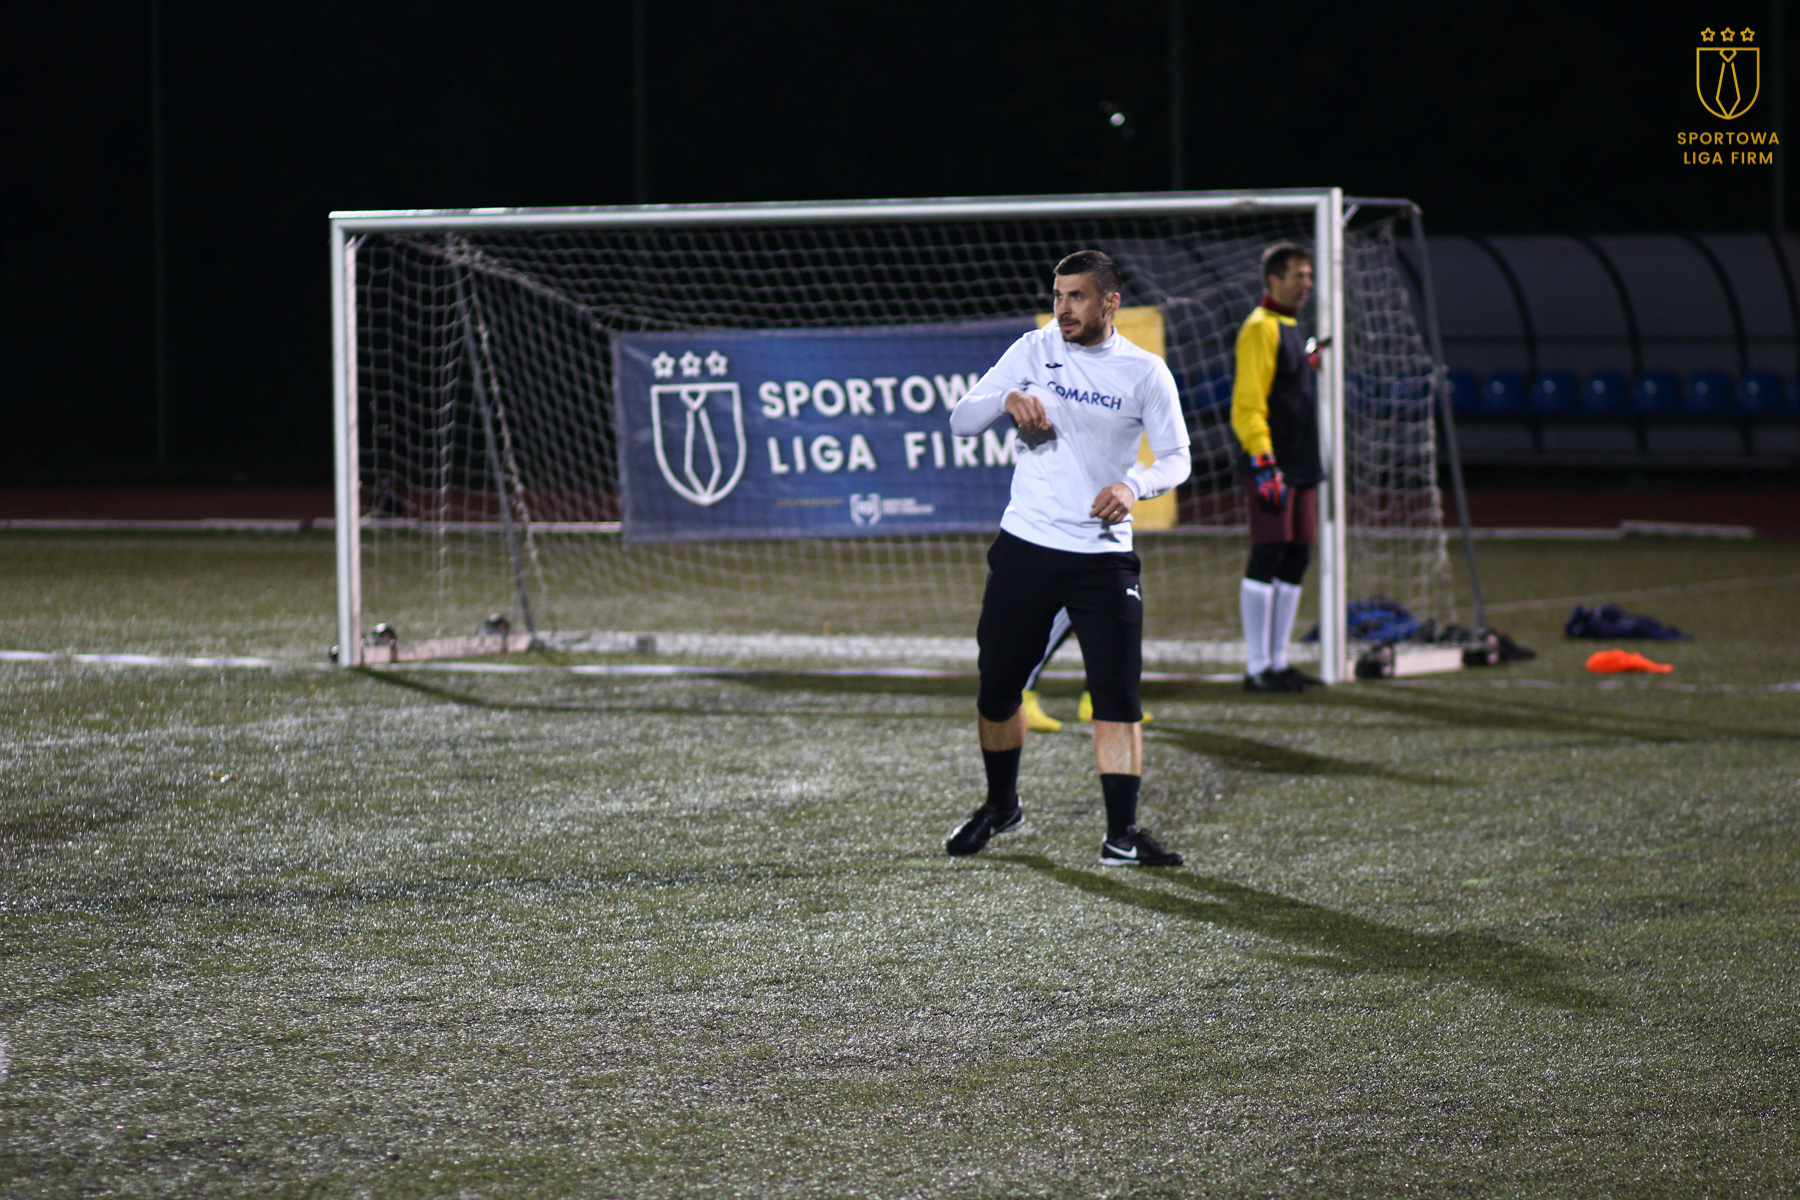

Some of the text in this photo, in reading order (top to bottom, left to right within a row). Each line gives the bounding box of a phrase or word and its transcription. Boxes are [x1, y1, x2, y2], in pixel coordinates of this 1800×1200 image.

[758, 373, 980, 419] SPORTOW
[767, 427, 1019, 474] LIGA FIRM
